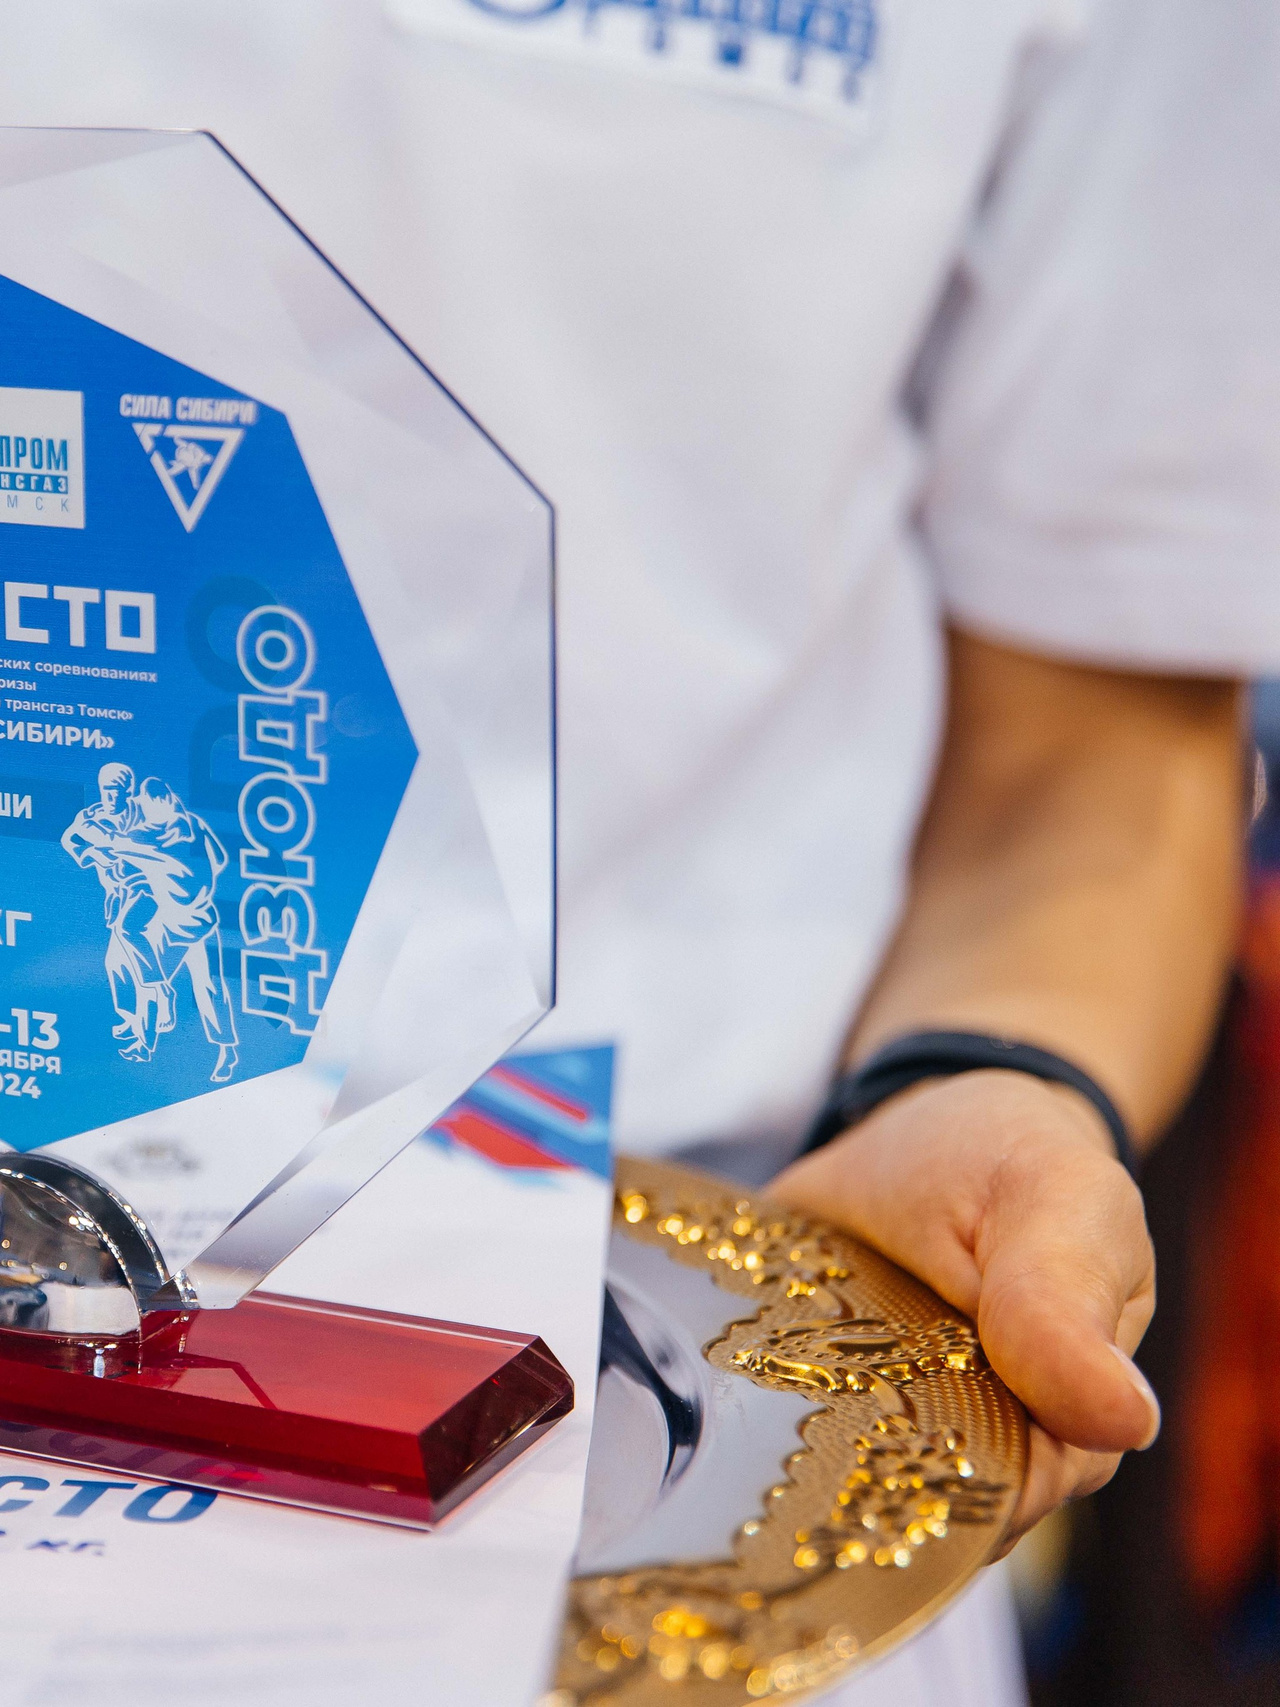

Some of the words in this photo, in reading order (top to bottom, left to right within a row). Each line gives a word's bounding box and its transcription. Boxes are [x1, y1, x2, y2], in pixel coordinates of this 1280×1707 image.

[120, 393, 170, 419] СИЛА
[176, 396, 257, 425] СИБИРИ
[34, 661, 158, 683] соревнованиях
[4, 698, 74, 715] трансгаз
[77, 704, 134, 721] Томск»
[236, 604, 328, 1038] ДЗЮДО
